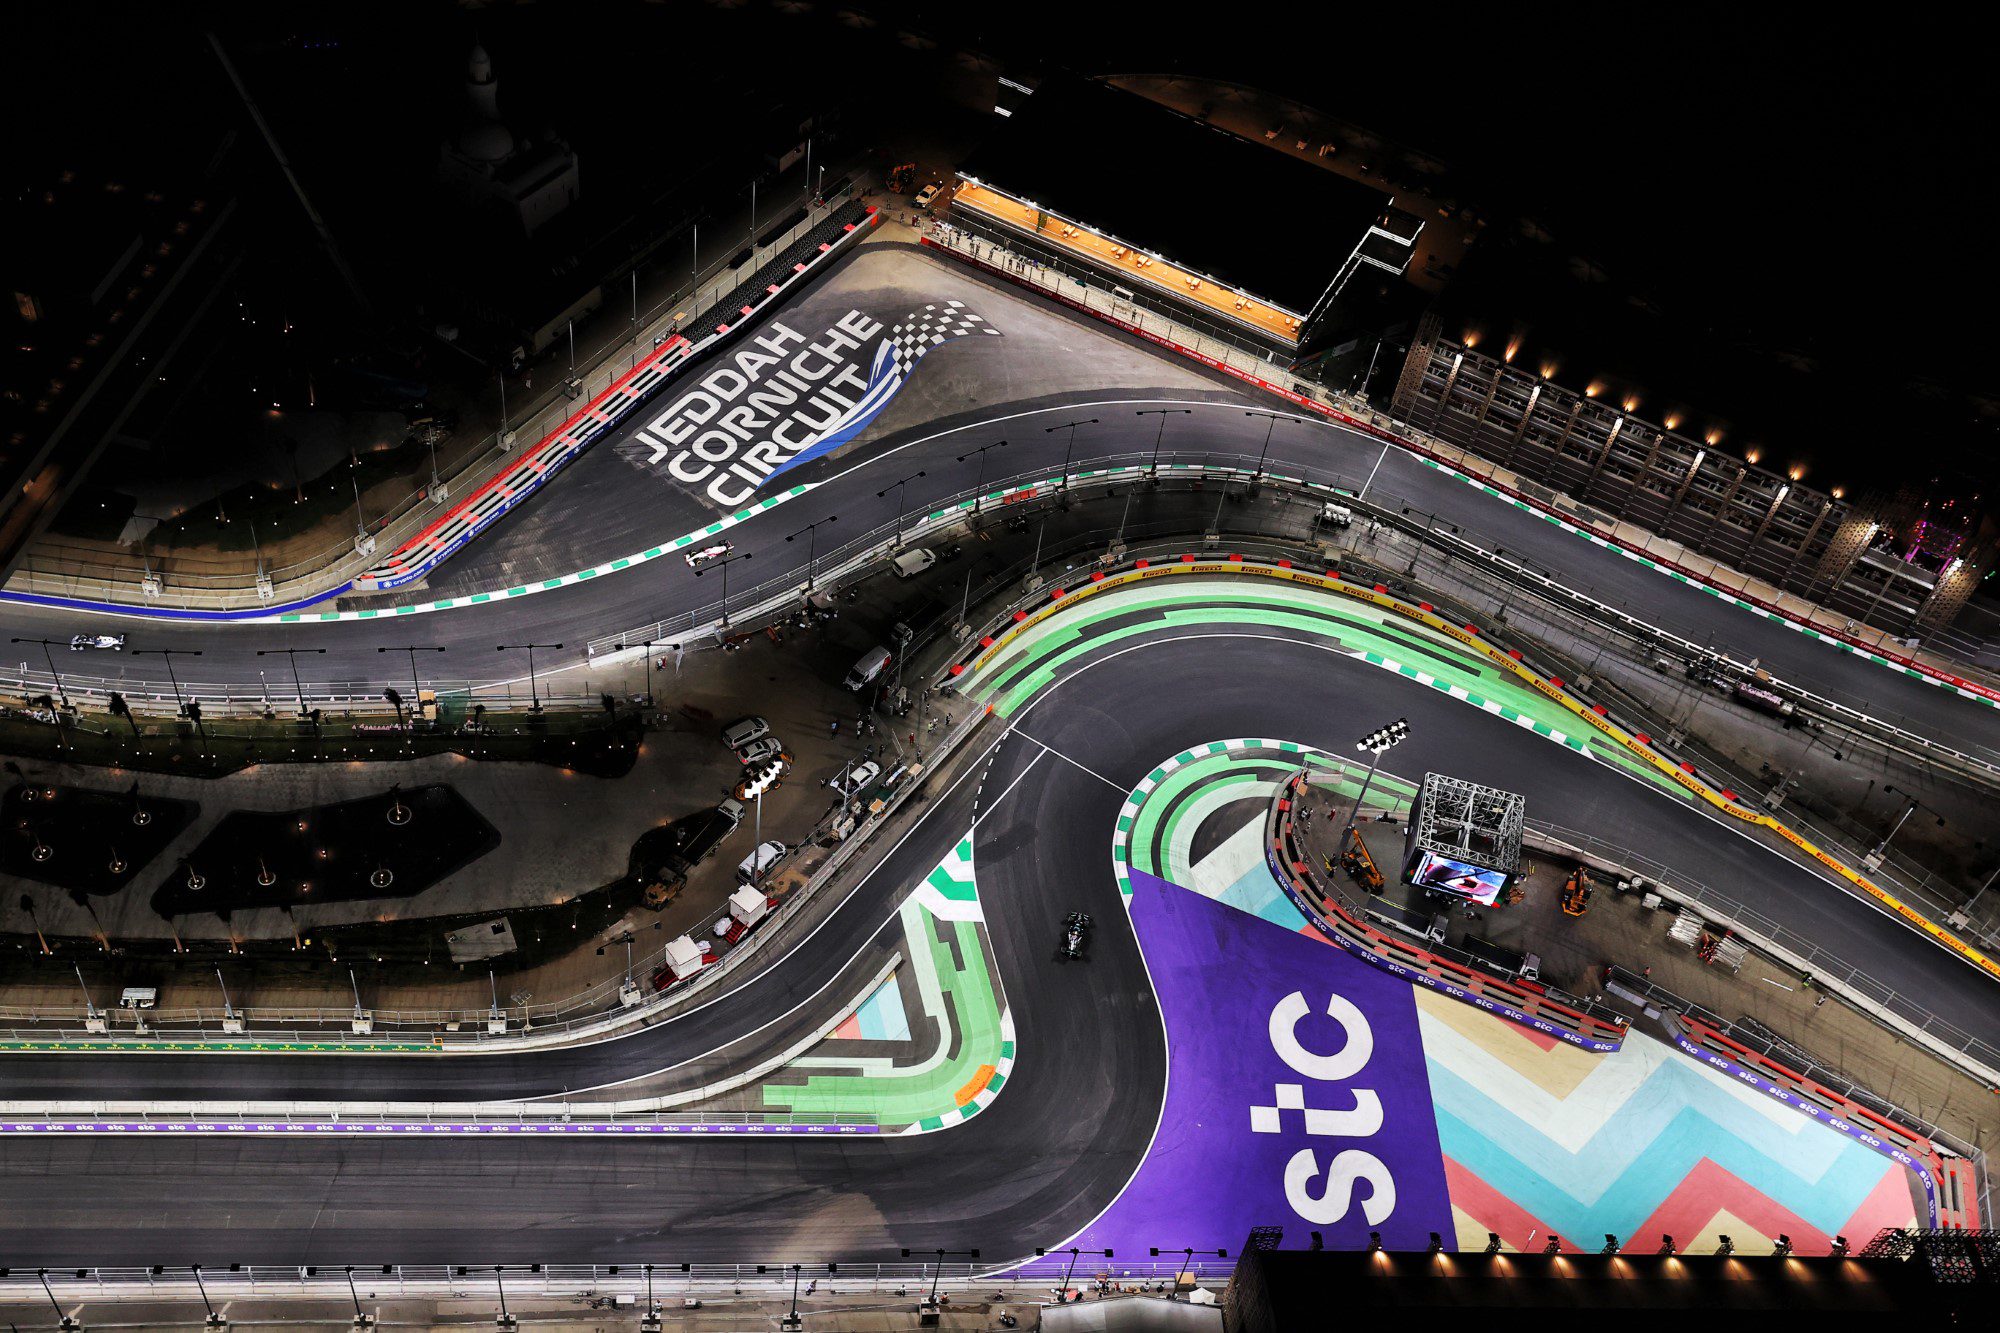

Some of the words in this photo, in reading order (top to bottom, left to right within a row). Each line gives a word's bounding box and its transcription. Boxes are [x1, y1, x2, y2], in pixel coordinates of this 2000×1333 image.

[634, 322, 806, 464] JEDDAH
[668, 310, 884, 482] CORNICHE
[706, 363, 869, 506] CIRCUIT
[511, 484, 535, 504] crypto.com
[475, 512, 499, 531] crypto.com
[437, 540, 462, 560] crypto.com
[394, 568, 424, 585] crypto.com
[1142, 568, 1172, 577] PIRELLI
[1241, 566, 1273, 574] PIRELLI
[1097, 578, 1124, 591] PIRELLI
[1292, 574, 1324, 586] PIRELLI
[1344, 586, 1374, 601] PIRELLI
[1055, 594, 1080, 610] PIRELLI
[1393, 604, 1424, 620] PIRELLI
[1016, 616, 1040, 633] PIRELLI
[1442, 625, 1472, 643] PIRELLI
[982, 642, 1003, 663] PIRELLI
[1489, 650, 1518, 670] PIRELLI
[1534, 680, 1563, 700] PIRELLI
[1581, 710, 1610, 731] PIRELLI
[1628, 741, 1657, 762] PIRELLI
[1675, 772, 1705, 794] PIRELLI
[1724, 804, 1758, 821] PIRELLI
[1278, 875, 1288, 890] stc
[1294, 897, 1305, 911] stc
[1313, 918, 1327, 932] stc
[1335, 935, 1350, 948] stc
[1362, 952, 1378, 962] stc
[1389, 965, 1406, 974] stc
[1419, 976, 1435, 986] stc
[1446, 987, 1464, 997] stc
[1475, 998, 1493, 1009] stc
[1505, 1010, 1523, 1020] stc
[1535, 1022, 1553, 1031] stc
[1564, 1033, 1582, 1043] stc
[1681, 1040, 1698, 1054] stc
[1709, 1057, 1728, 1068] stc
[1739, 1071, 1758, 1084] stc
[1769, 1086, 1788, 1100] stc
[1250, 990, 1396, 1226] stc
[1799, 1102, 1818, 1115] stc
[1829, 1118, 1849, 1131] stc
[1860, 1134, 1880, 1147] stc
[1891, 1150, 1912, 1164] stc
[1919, 1170, 1931, 1189] stc
